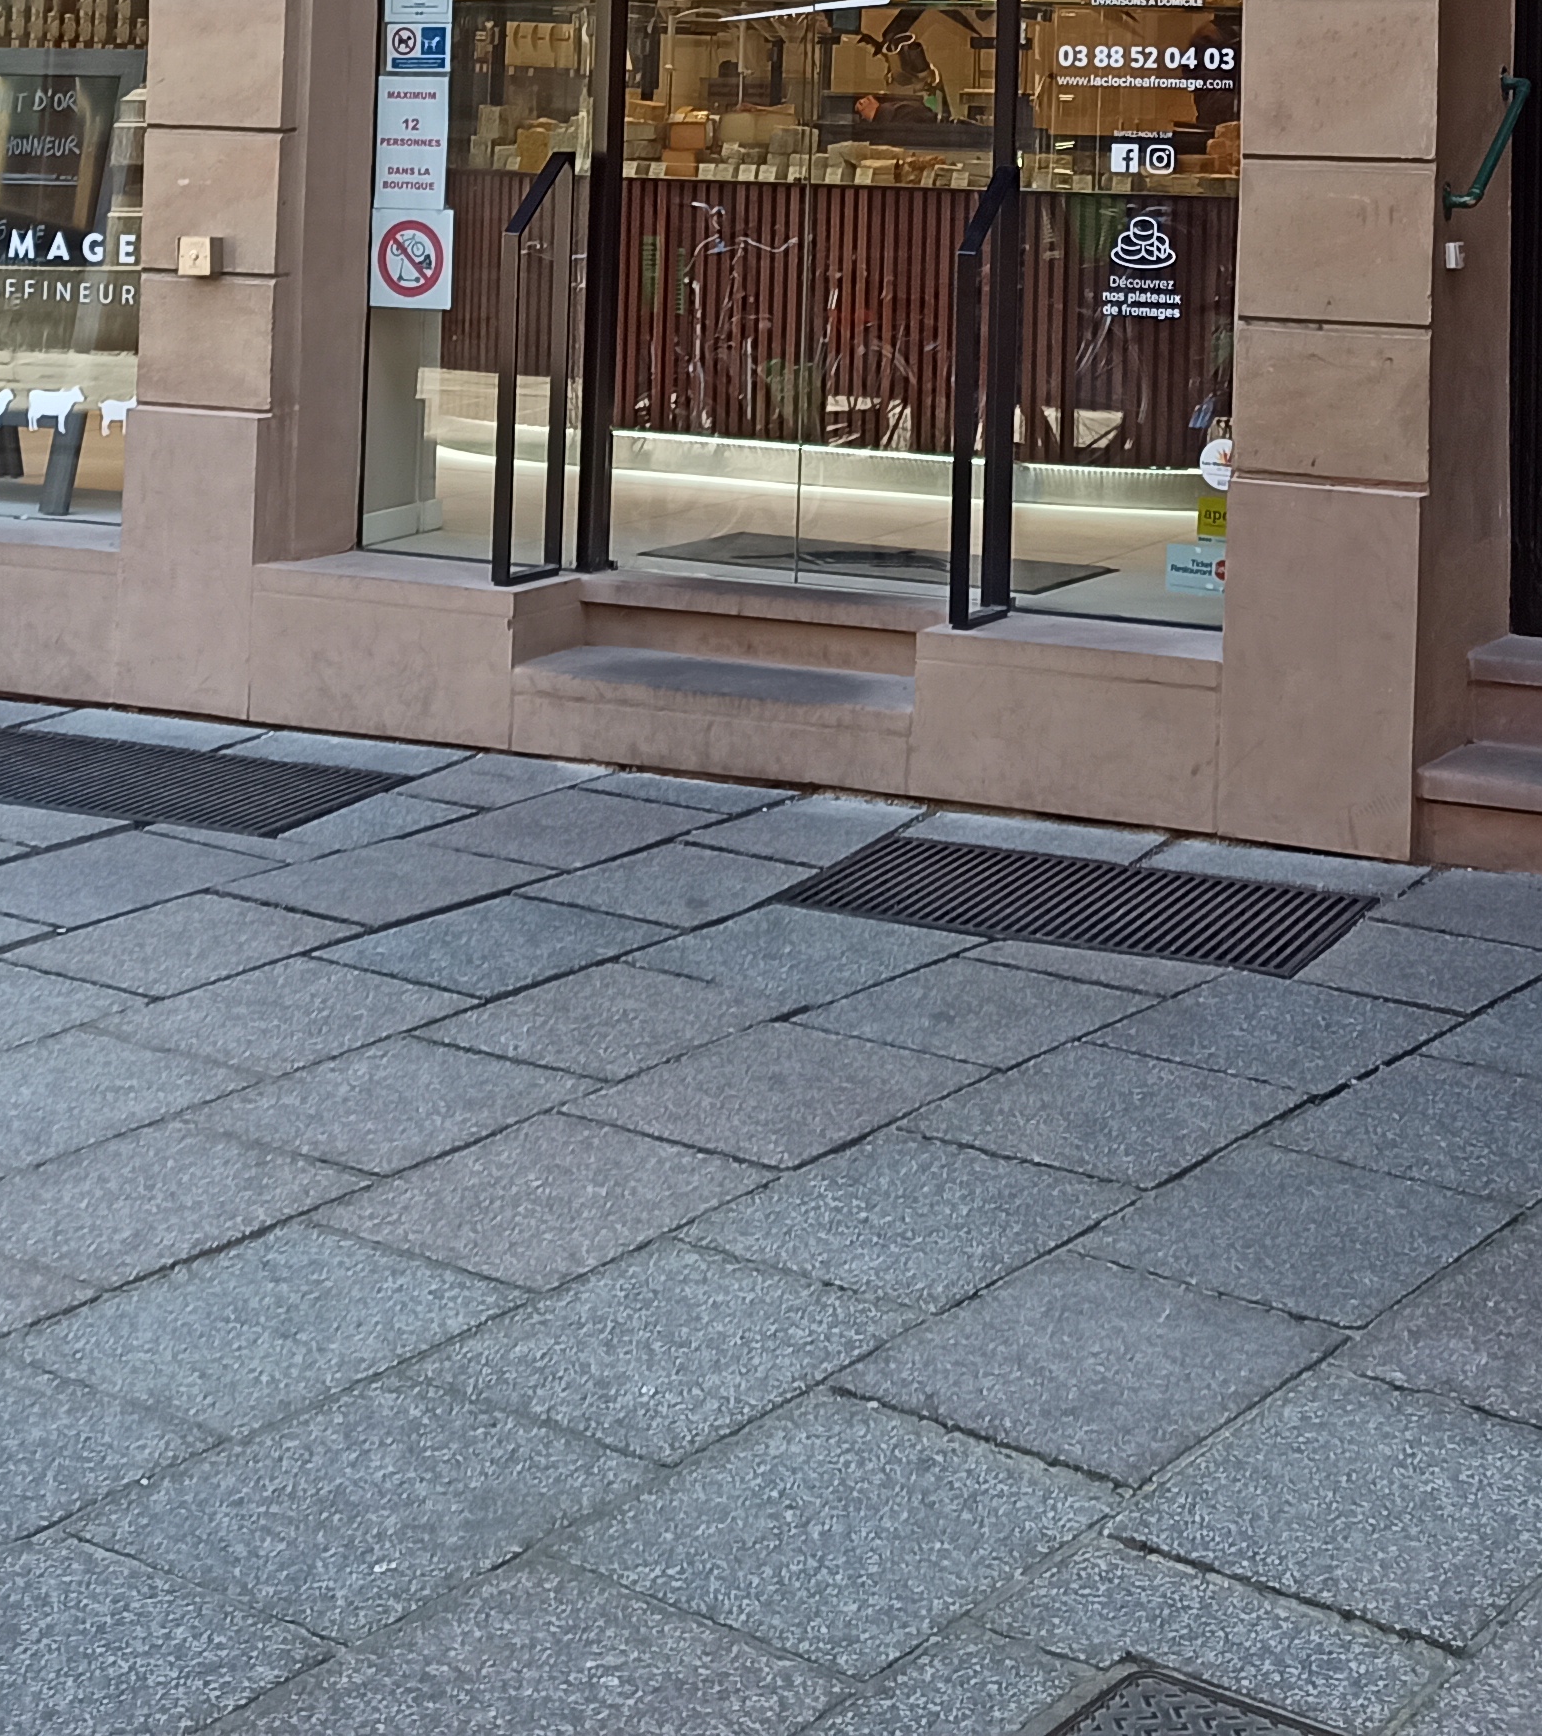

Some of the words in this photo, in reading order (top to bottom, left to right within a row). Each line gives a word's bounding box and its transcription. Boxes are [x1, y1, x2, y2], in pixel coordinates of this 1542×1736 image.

[1058, 45, 1088, 68] 03
[1093, 45, 1125, 68] 88
[1130, 46, 1158, 69] 52
[1164, 47, 1198, 70] 04
[1203, 47, 1235, 71] 03
[1056, 74, 1234, 91] www.laclocheafromage.com
[386, 90, 437, 100] MAXIMUM
[402, 118, 420, 131] 12
[379, 137, 442, 148] PERSONNES
[387, 166, 416, 176] DANS
[417, 167, 431, 176] LA
[382, 180, 435, 191] BOUTIQUE
[1109, 275, 1175, 290] Découvrez
[1102, 291, 1125, 302] nos
[1127, 290, 1182, 305] plateaux
[1102, 303, 1119, 316] de
[1121, 303, 1181, 320] fromages
